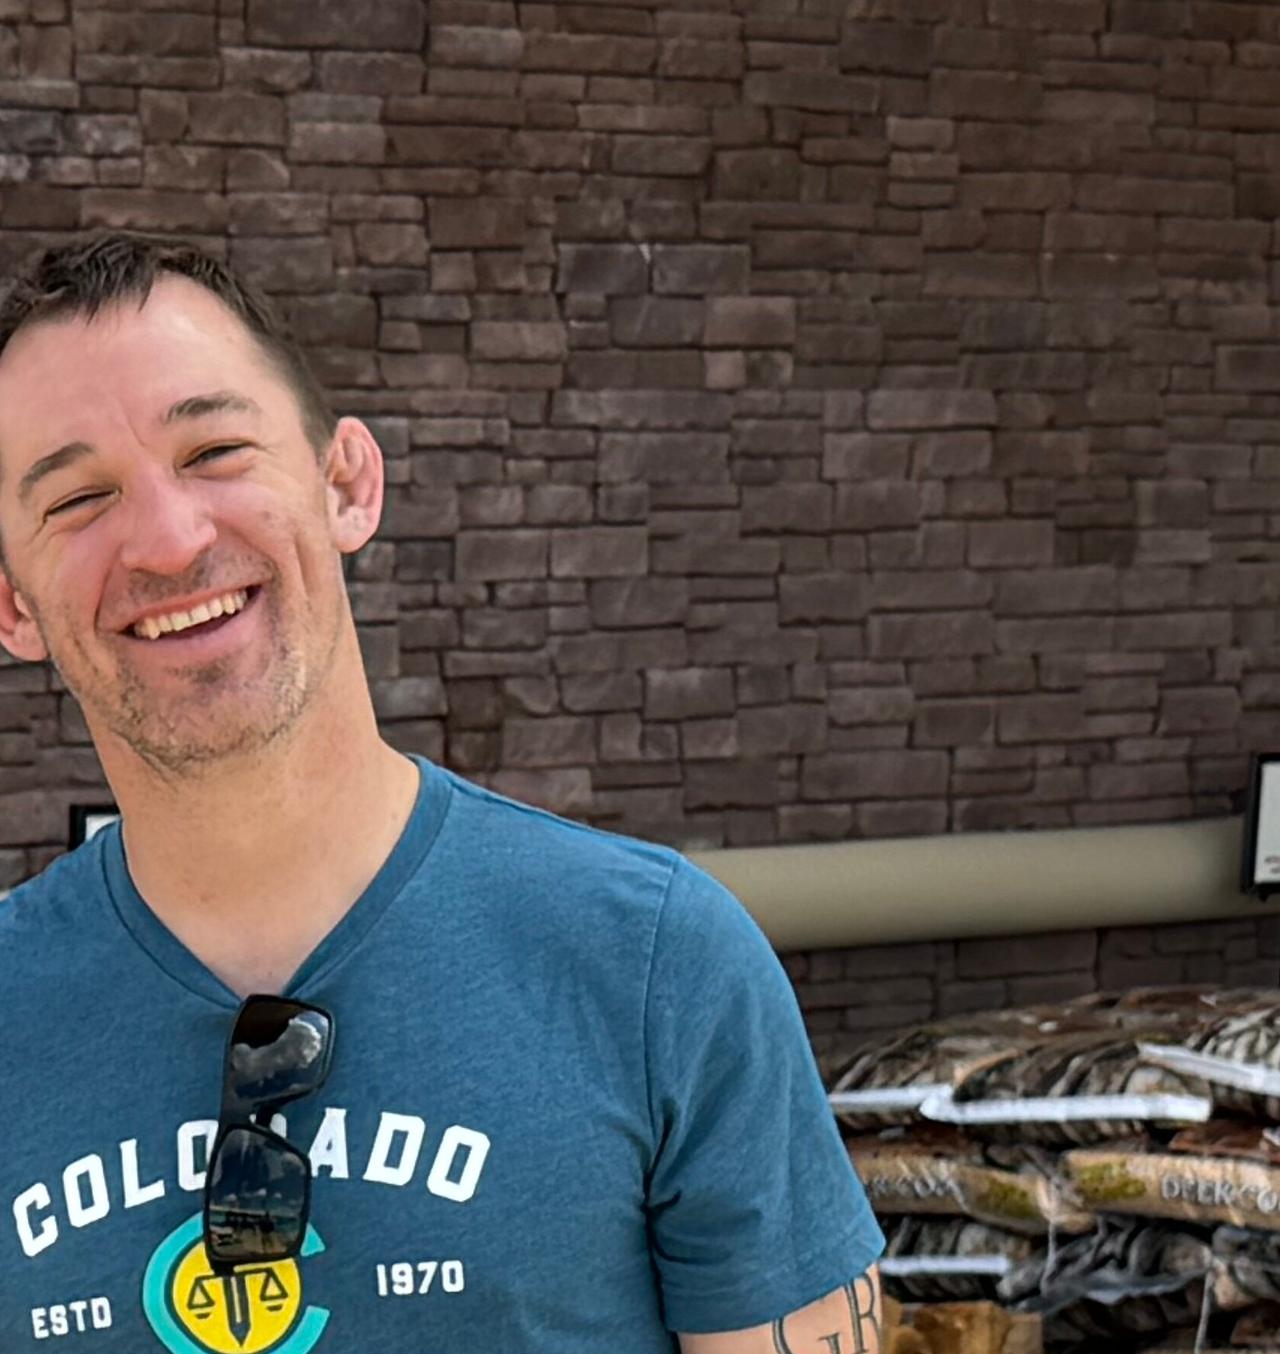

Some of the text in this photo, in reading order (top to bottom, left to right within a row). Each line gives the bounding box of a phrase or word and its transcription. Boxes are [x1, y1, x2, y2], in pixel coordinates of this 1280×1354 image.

[12, 1106, 492, 1258] COLOADO
[376, 1259, 465, 1297] 1970
[30, 1296, 114, 1340] ESTD
